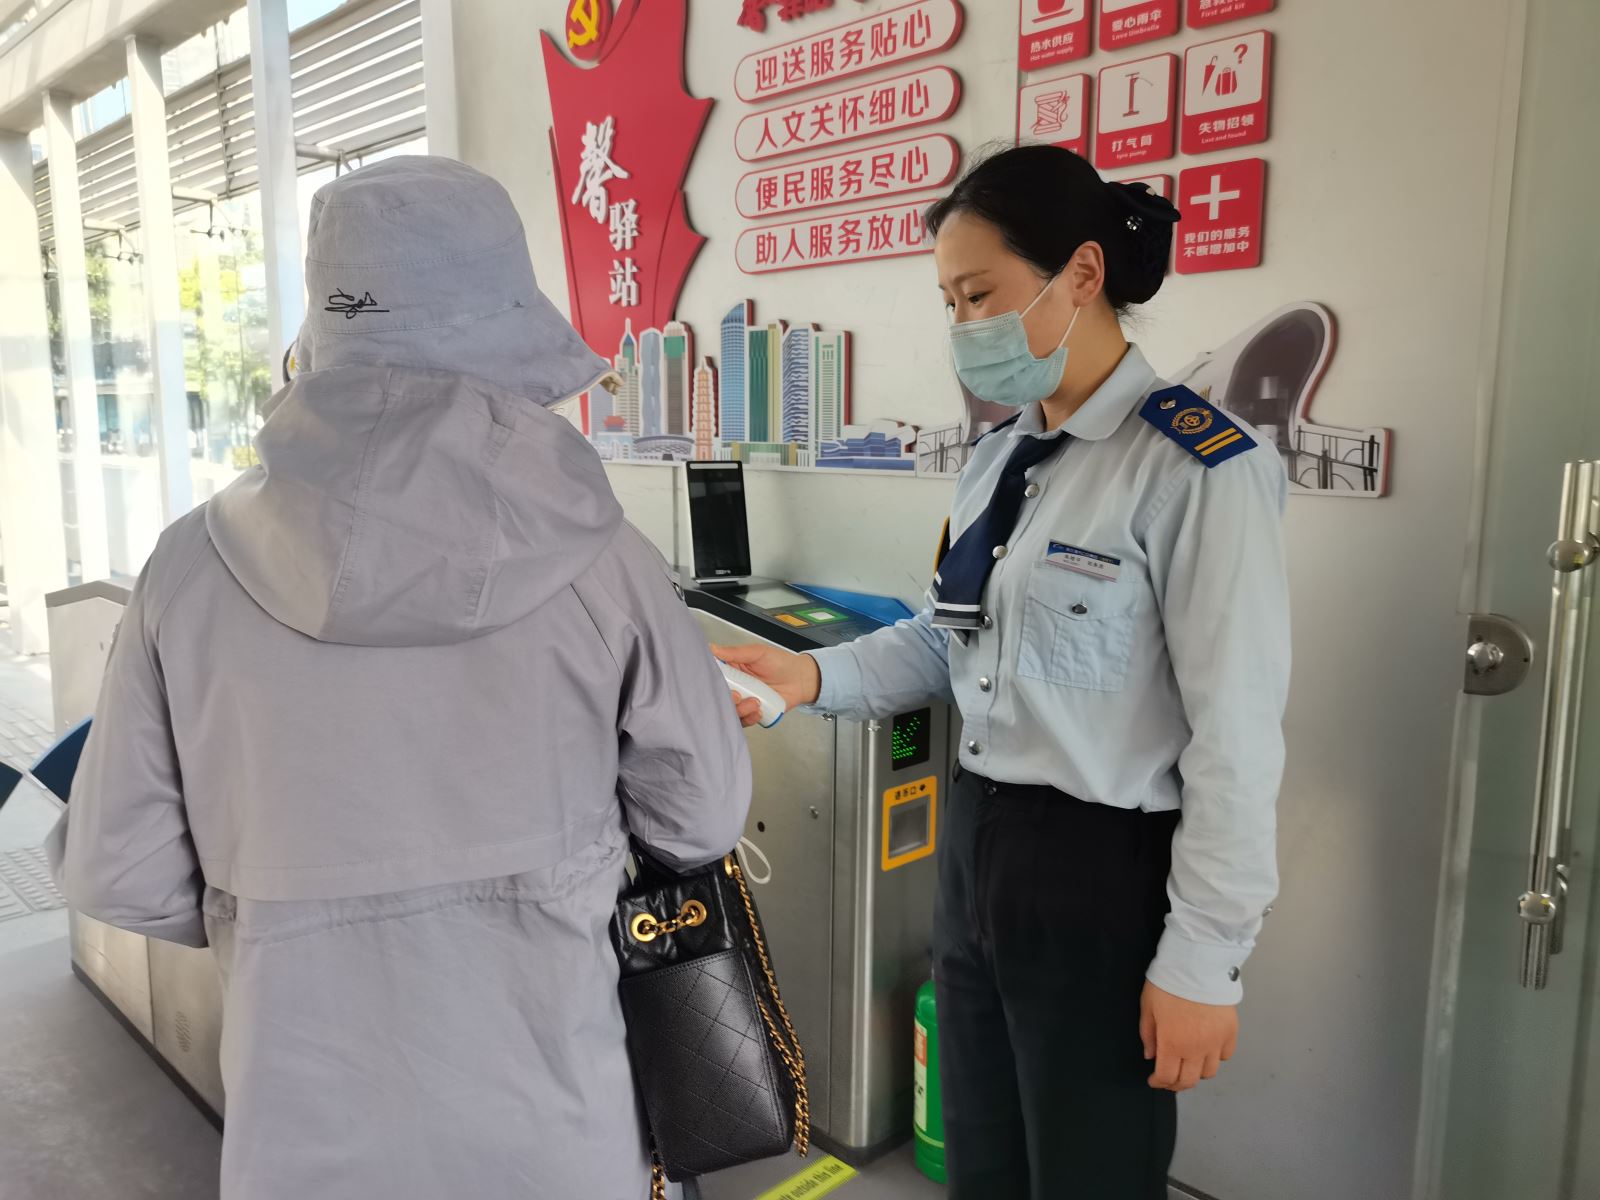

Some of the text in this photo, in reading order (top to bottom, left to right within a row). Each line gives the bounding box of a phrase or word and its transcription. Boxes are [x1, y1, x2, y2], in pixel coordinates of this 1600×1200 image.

[1112, 10, 1161, 32] 爱心雨伞
[1201, 2, 1246, 18] First aid kit
[755, 9, 931, 93] 迎送服务贴心
[1030, 32, 1073, 54] 热水供应
[755, 79, 929, 153] 人文关怀细心
[1199, 113, 1254, 135] 失物招领
[1112, 134, 1152, 152] 打气筒
[755, 146, 929, 212] 便民服务尽心
[571, 115, 640, 308] 馨驿站
[755, 208, 928, 265] 助人服务放心
[1184, 226, 1250, 244] 我们的服务
[1183, 241, 1250, 257] 不断增加中
